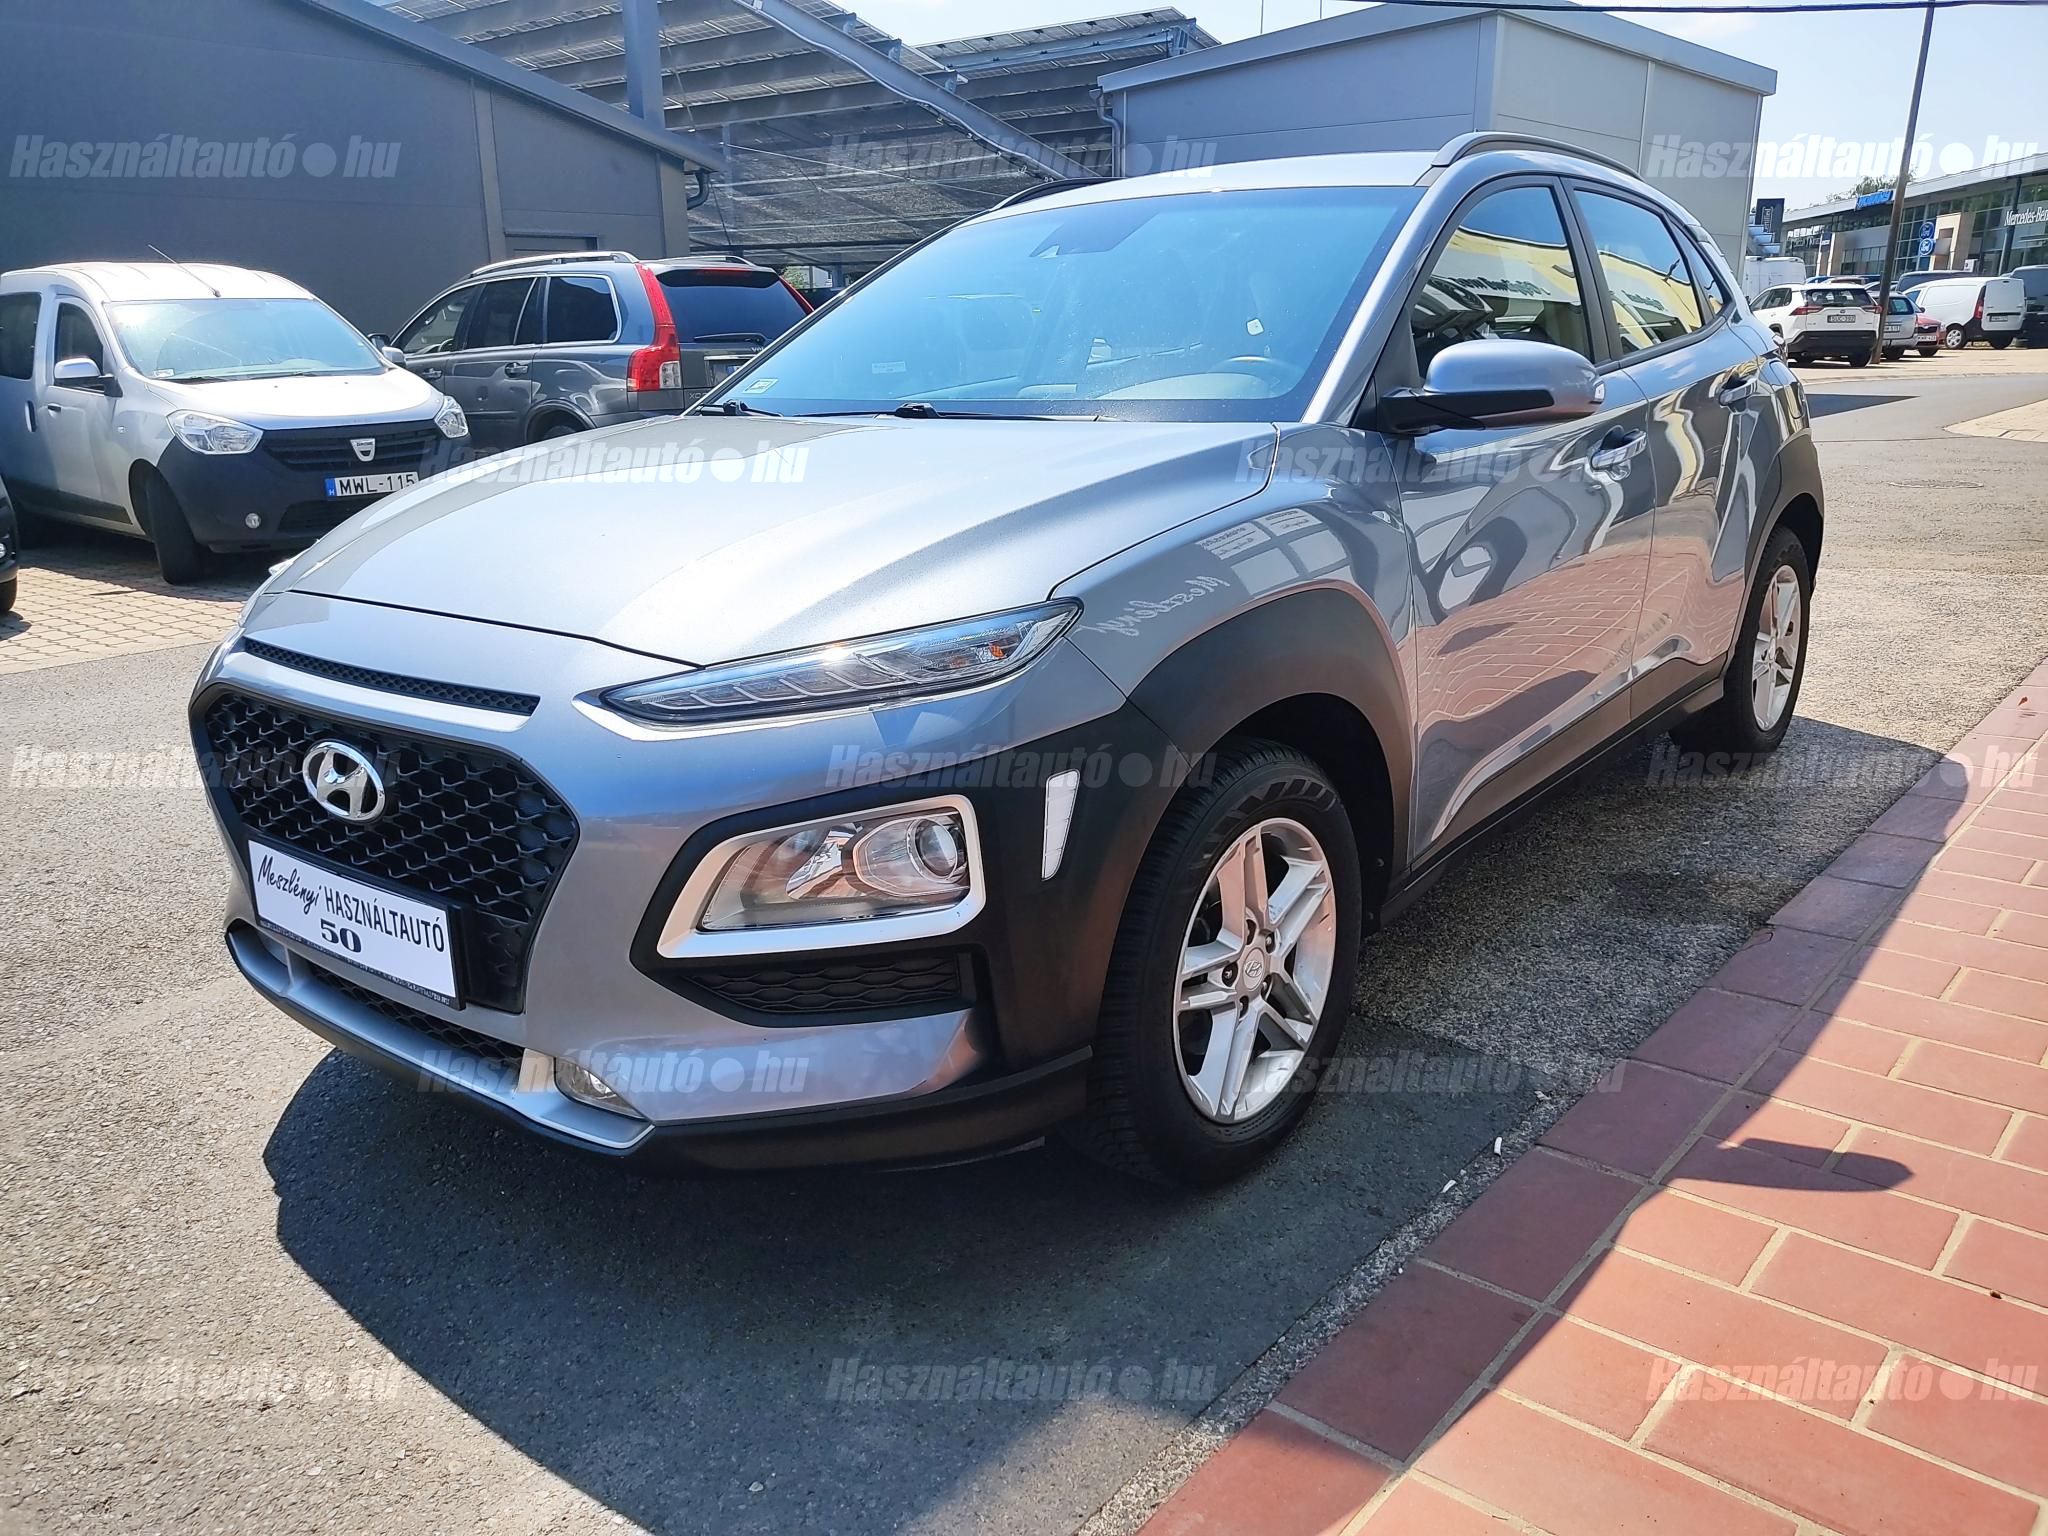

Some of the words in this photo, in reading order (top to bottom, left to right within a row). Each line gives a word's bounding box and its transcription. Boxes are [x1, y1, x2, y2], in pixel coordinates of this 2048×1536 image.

[339, 474, 415, 495] MWL-115
[257, 854, 322, 915] Meszlényi
[324, 886, 445, 952] HASZNÁLTAUTÓ
[320, 918, 362, 953] 50
